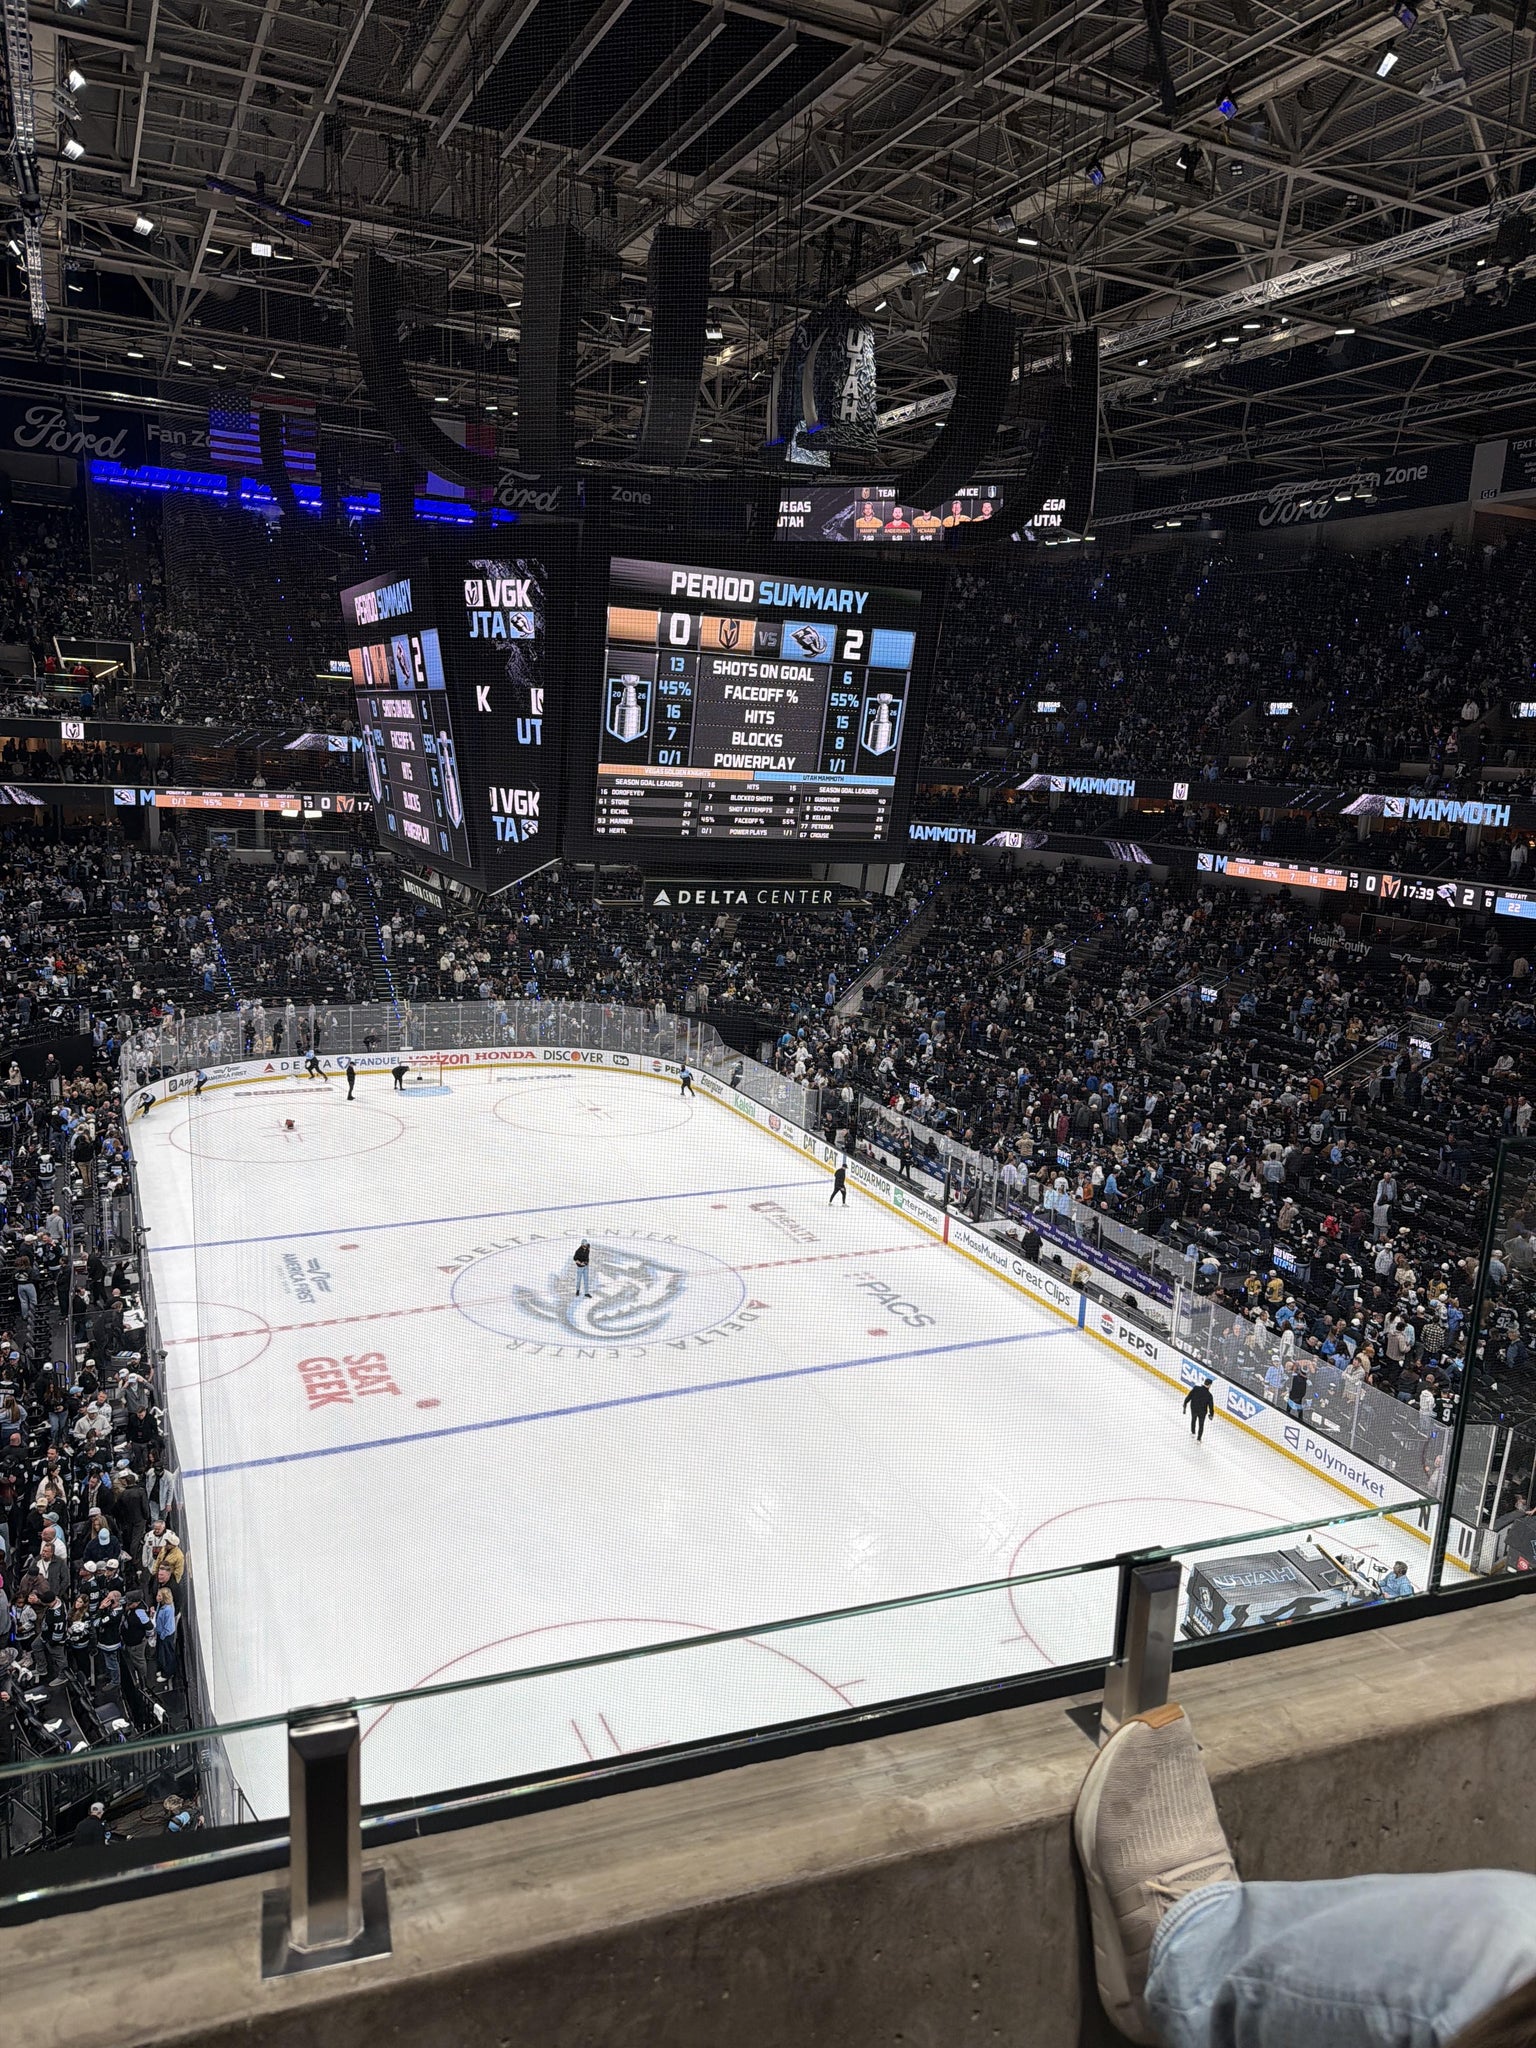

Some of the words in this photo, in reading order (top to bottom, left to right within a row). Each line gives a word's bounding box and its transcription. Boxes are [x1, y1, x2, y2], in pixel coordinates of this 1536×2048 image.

[840, 328, 865, 422] UTAH
[14, 405, 128, 458] Ford
[148, 424, 187, 445] Fan
[1384, 464, 1428, 486] Zone
[493, 467, 562, 512] Ford
[611, 486, 651, 504] Zone
[966, 488, 978, 496] ICE
[376, 579, 412, 620] SUMMARY
[486, 580, 533, 607] VGK
[671, 571, 754, 602] PERIOD
[758, 581, 869, 614] SUMMARY
[669, 612, 691, 645] 0
[759, 631, 778, 647] VS
[843, 629, 864, 660] 2
[412, 637, 424, 682] 2
[670, 657, 684, 672] 13
[713, 660, 757, 678] SHOTS
[760, 664, 778, 678] ON
[781, 666, 814, 682] GOAL
[843, 671, 852, 684] 6
[659, 680, 692, 696] 45%
[724, 685, 784, 701] FACEOFF
[787, 689, 799, 703] %
[476, 685, 492, 712] K
[830, 693, 860, 707] 55%
[666, 704, 681, 719] 16
[744, 709, 775, 724] HITS
[516, 718, 542, 745] UT
[836, 716, 849, 729] 15
[667, 727, 677, 740] 7
[732, 731, 783, 747] BLOCKS
[835, 737, 844, 749] 8
[658, 750, 681, 765] 0/1
[714, 753, 796, 770] POWERPLAY
[830, 759, 845, 772] 1/1
[1068, 777, 1135, 796] MAMMOTH
[140, 789, 155, 806] M
[172, 797, 186, 805] 0/1
[203, 798, 222, 806] 45%
[260, 800, 269, 808] 16
[304, 800, 313, 808] 13
[322, 797, 330, 809] 0
[500, 788, 540, 817] VGK
[1408, 798, 1510, 827] MAMMOTH
[492, 816, 519, 843] TA
[1215, 855, 1228, 874] M
[1262, 870, 1278, 879] 45%
[1366, 876, 1376, 891] 0
[1350, 880, 1358, 888] 13
[1403, 885, 1434, 900] 17:39
[423, 889, 442, 909] CENTER
[678, 890, 748, 905] DELTA
[757, 890, 832, 904] CENTER
[1463, 889, 1474, 905] 2
[1485, 898, 1492, 907] 6
[1508, 903, 1520, 912] 22
[354, 1056, 400, 1066] FANDUEL
[475, 1051, 536, 1060] HONDA
[544, 1050, 603, 1063] DISCOVER
[231, 1070, 247, 1078] FIRST
[281, 1060, 331, 1071] DEA
[665, 1064, 680, 1075] PEP
[701, 1075, 723, 1095] Energizer
[734, 1093, 756, 1118] Kalshi
[804, 1134, 816, 1155] CAT
[824, 1147, 838, 1168] CAT
[40, 1163, 53, 1173] 50
[851, 1163, 891, 1195] BODYARMOR
[898, 1194, 938, 1224] enterprise
[454, 1233, 547, 1263] DELTA
[564, 1228, 679, 1243] CENTER
[962, 1234, 1008, 1268] MassMutual
[282, 1254, 306, 1284] AMERICA
[296, 1282, 315, 1303] FIRST
[1012, 1260, 1043, 1290] Great
[1045, 1280, 1070, 1306] Clips
[856, 1280, 936, 1328] PACS
[666, 1311, 760, 1350] DELTA
[506, 1339, 647, 1359] CENTER
[1119, 1326, 1158, 1360] PEPSI
[342, 1352, 402, 1396] SEAT
[298, 1357, 353, 1411] GEEK
[1228, 1393, 1256, 1418] SAP
[1443, 1408, 1450, 1422] 9
[1305, 1438, 1384, 1498] Polymarket
[1213, 1566, 1296, 1589] UTAH
[54, 1622, 64, 1630] 77
[1194, 1606, 1213, 1632] UTAH
